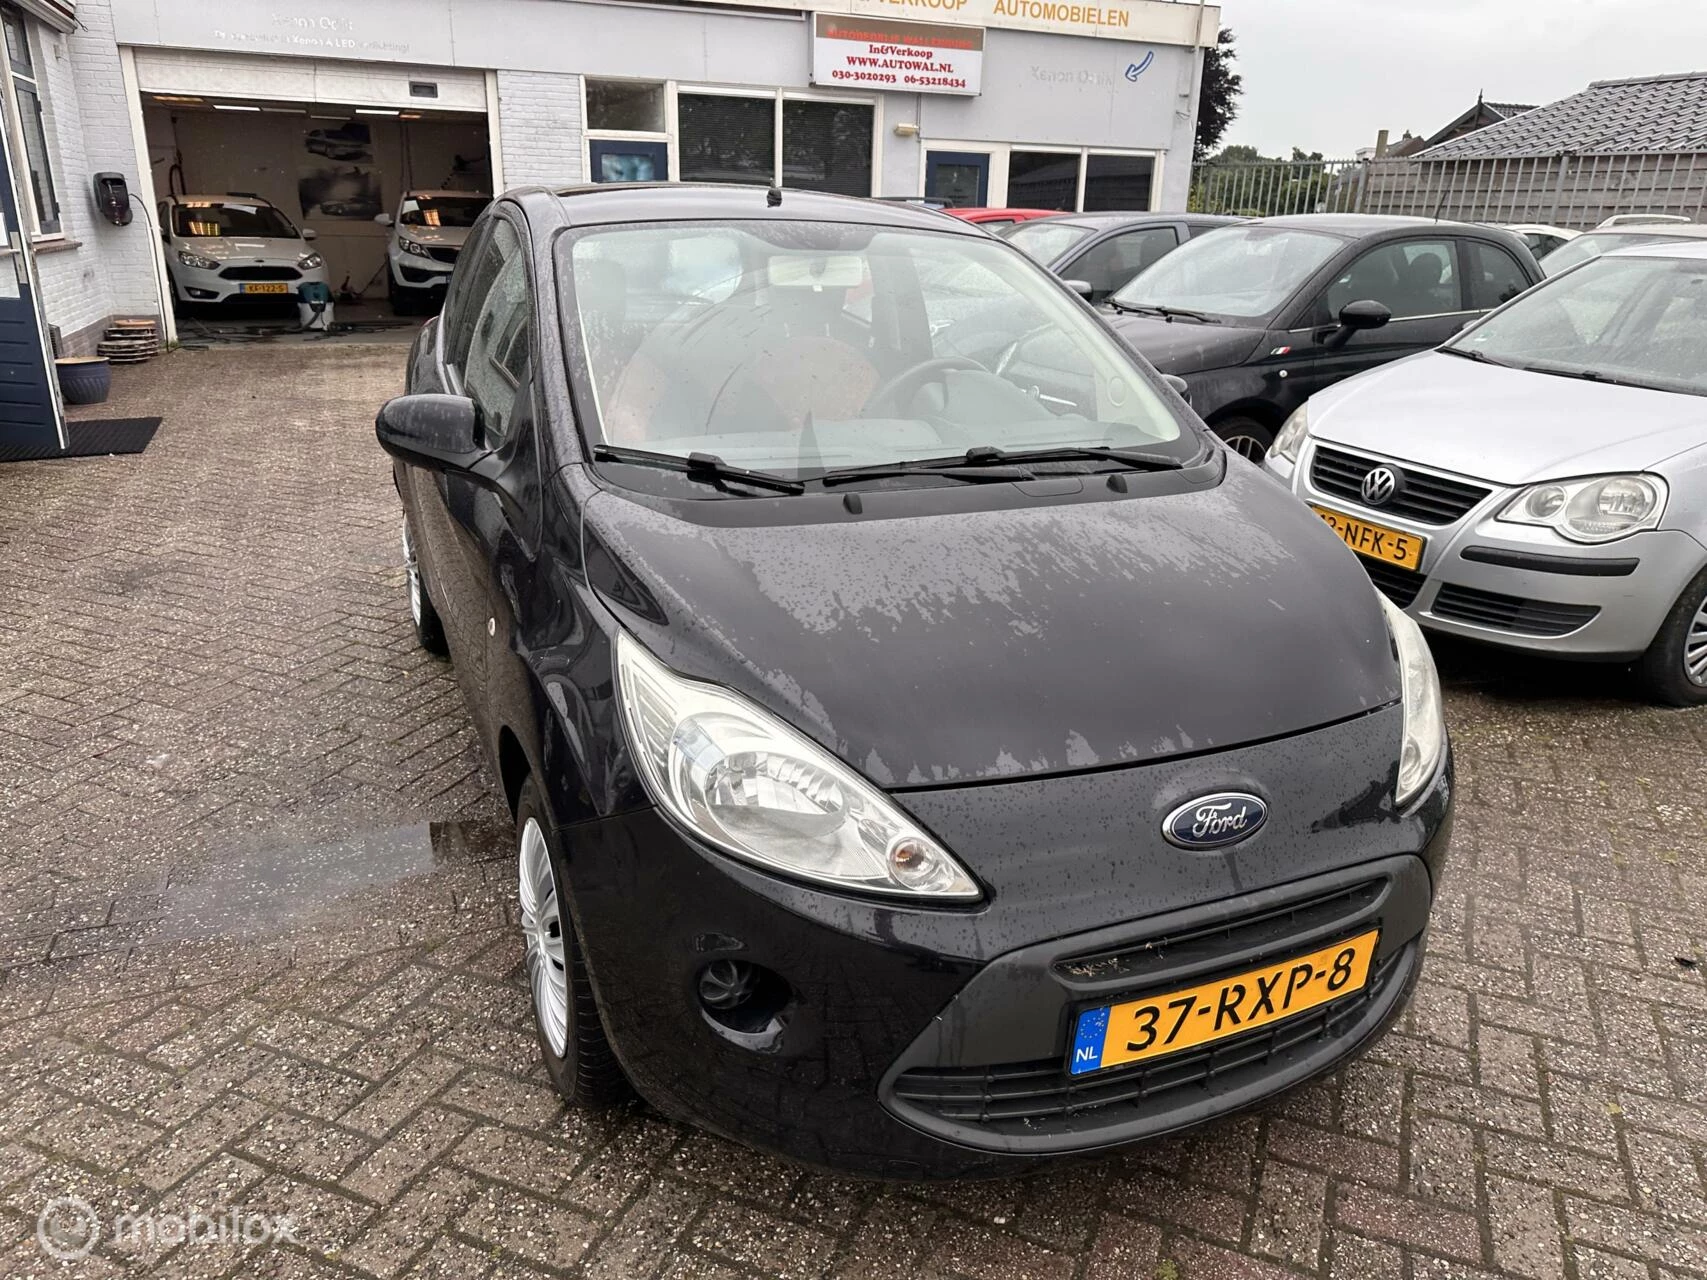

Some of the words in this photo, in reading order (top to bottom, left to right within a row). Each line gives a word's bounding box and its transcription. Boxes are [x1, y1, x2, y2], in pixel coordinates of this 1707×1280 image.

[993, 0, 1130, 27] AUTOMOBIELEN
[335, 38, 356, 49] LED
[846, 56, 954, 73] WWW.AUTOWAL.NL
[832, 70, 897, 83] 030-3020293
[1320, 514, 1408, 561] -NFK-5
[1192, 801, 1248, 838] Ford
[1126, 947, 1356, 1052] 37-RXP-8
[1075, 1045, 1098, 1063] NL
